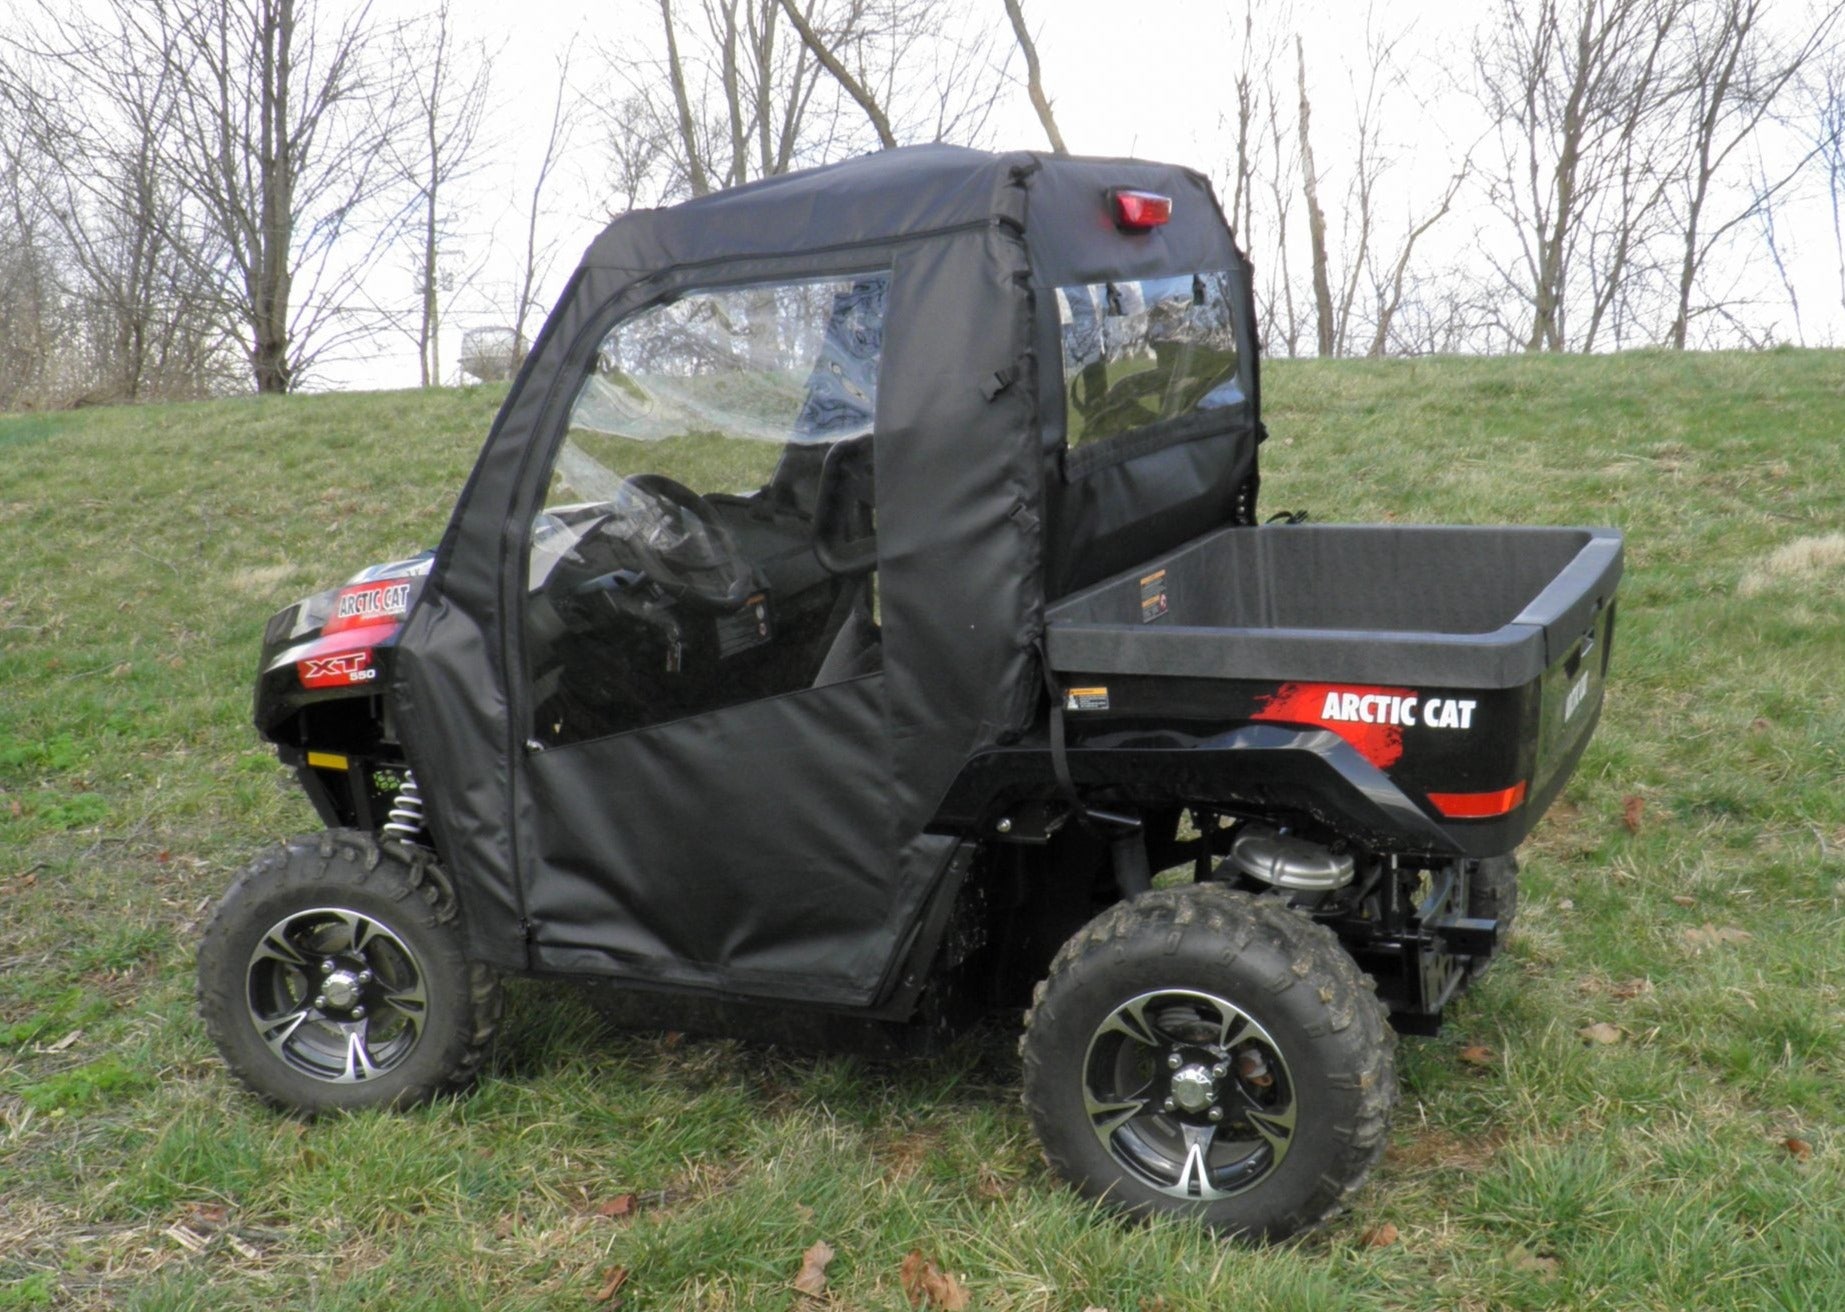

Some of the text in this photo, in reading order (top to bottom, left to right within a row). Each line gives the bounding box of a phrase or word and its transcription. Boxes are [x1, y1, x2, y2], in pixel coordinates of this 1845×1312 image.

[338, 584, 410, 618] ARCTIC CAT
[306, 653, 366, 679] XT
[350, 669, 376, 681] 550
[1321, 692, 1476, 729] ARCTIC CAT
